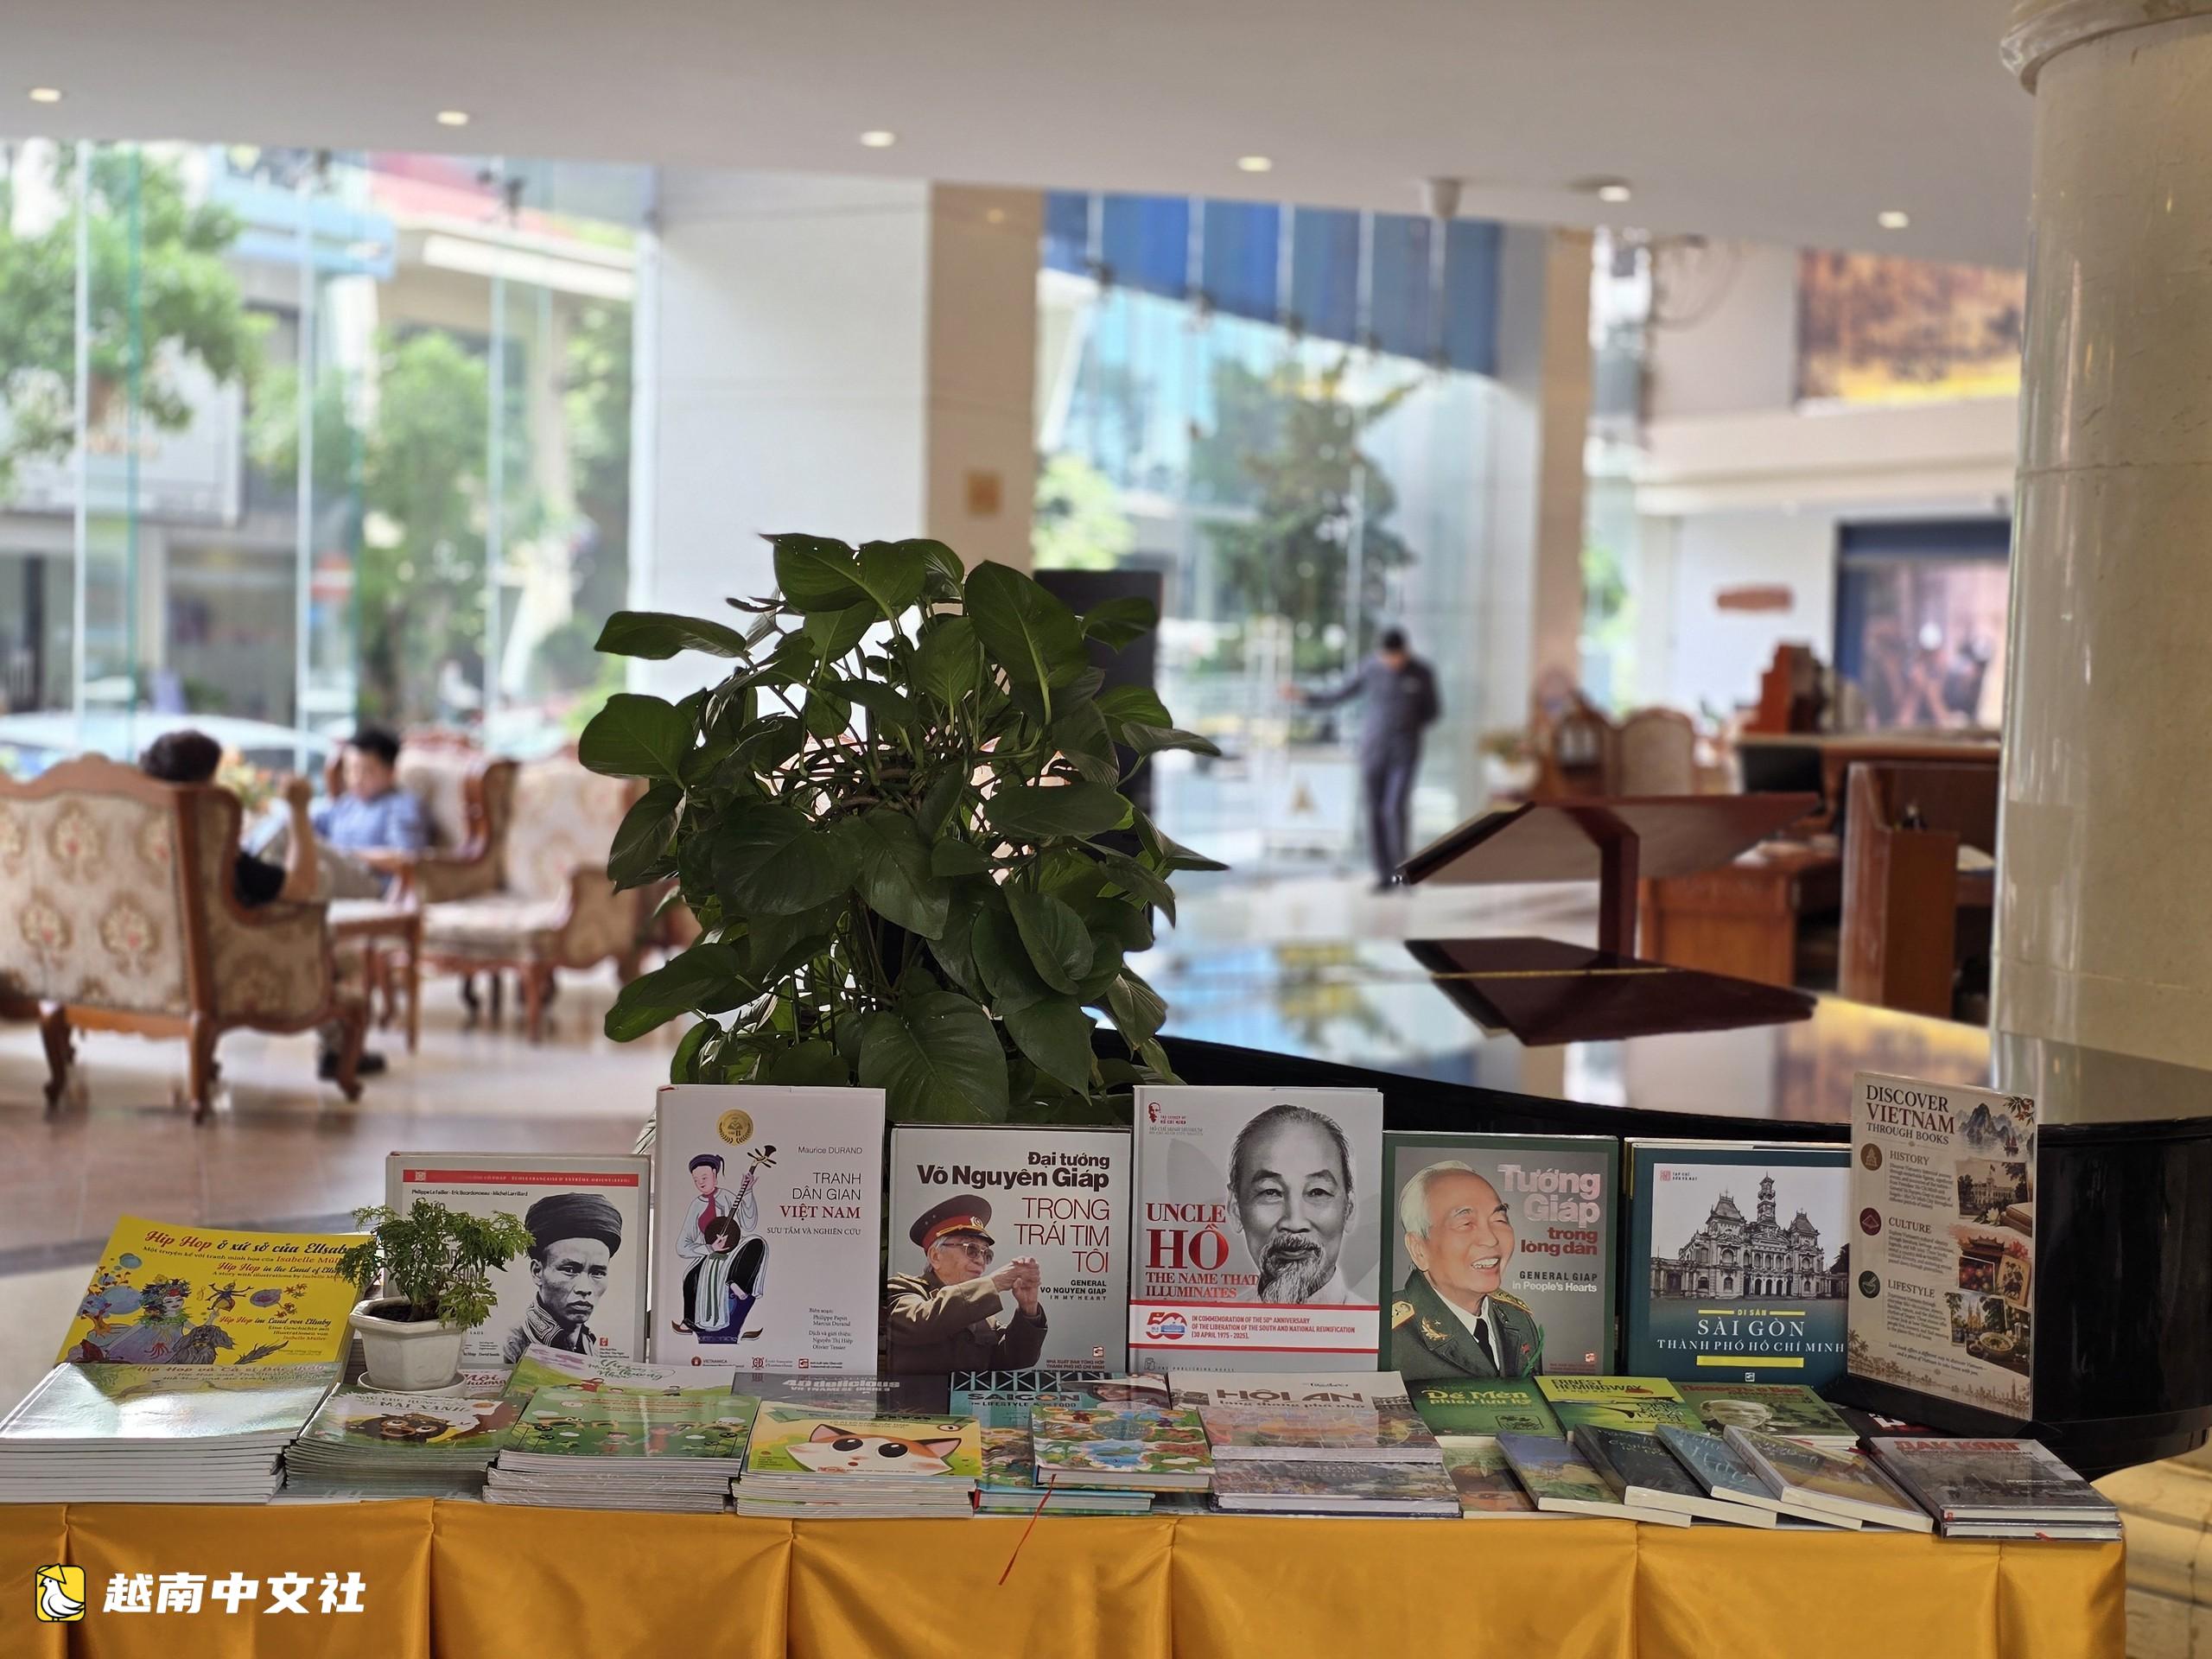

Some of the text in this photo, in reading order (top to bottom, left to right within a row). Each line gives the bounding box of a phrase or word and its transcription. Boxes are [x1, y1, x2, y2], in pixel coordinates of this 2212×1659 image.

[1866, 1085, 1948, 1113] DISCOVER
[1866, 1103, 1955, 1135] VIETNAM
[1866, 1122, 1948, 1145] THROUGH BOOKS
[1028, 1152, 1109, 1169] Đại tướng
[1890, 1151, 1929, 1166] HISTORY
[813, 1173, 861, 1184] TRANH
[917, 1165, 1109, 1192] Võ Nguyên Giáp
[1497, 1165, 1600, 1199] Tướng
[792, 1186, 861, 1200] DÂN GIAN
[779, 1204, 861, 1220] VIỆT NAM
[1022, 1198, 1109, 1220] TRONG
[1146, 1203, 1225, 1223] UNCLE
[1524, 1194, 1599, 1228] Giáp
[802, 1226, 811, 1235] VÀ
[1889, 1217, 1931, 1234] CULTURE
[145, 1231, 175, 1248] Hip
[180, 1236, 212, 1251] Hop
[1014, 1221, 1109, 1247] TRÁI TIM
[1548, 1227, 1597, 1243] trong
[1146, 1224, 1229, 1270] HỒ
[1521, 1240, 1560, 1256] lòng
[217, 1262, 236, 1272] Hip
[239, 1263, 260, 1273] Hop
[1072, 1249, 1108, 1274] TÔI
[1146, 1272, 1258, 1286] THE NAME THAT
[1520, 1271, 1598, 1281] GENERAL GIAP
[1146, 1286, 1237, 1298] ILLUMINATES
[1524, 1281, 1563, 1292] People's
[1566, 1283, 1597, 1292] Hearts
[1888, 1279, 1936, 1298] LIFESTYLE
[219, 1316, 235, 1325] Hip
[1697, 1317, 1805, 1336] SÀI GÒN
[1657, 1338, 1845, 1353] THÀNH PHỐ HỒ CHÍ MINH
[968, 1393, 1079, 1402] SAIGON
[1216, 1389, 1363, 1403] HỘI AN
